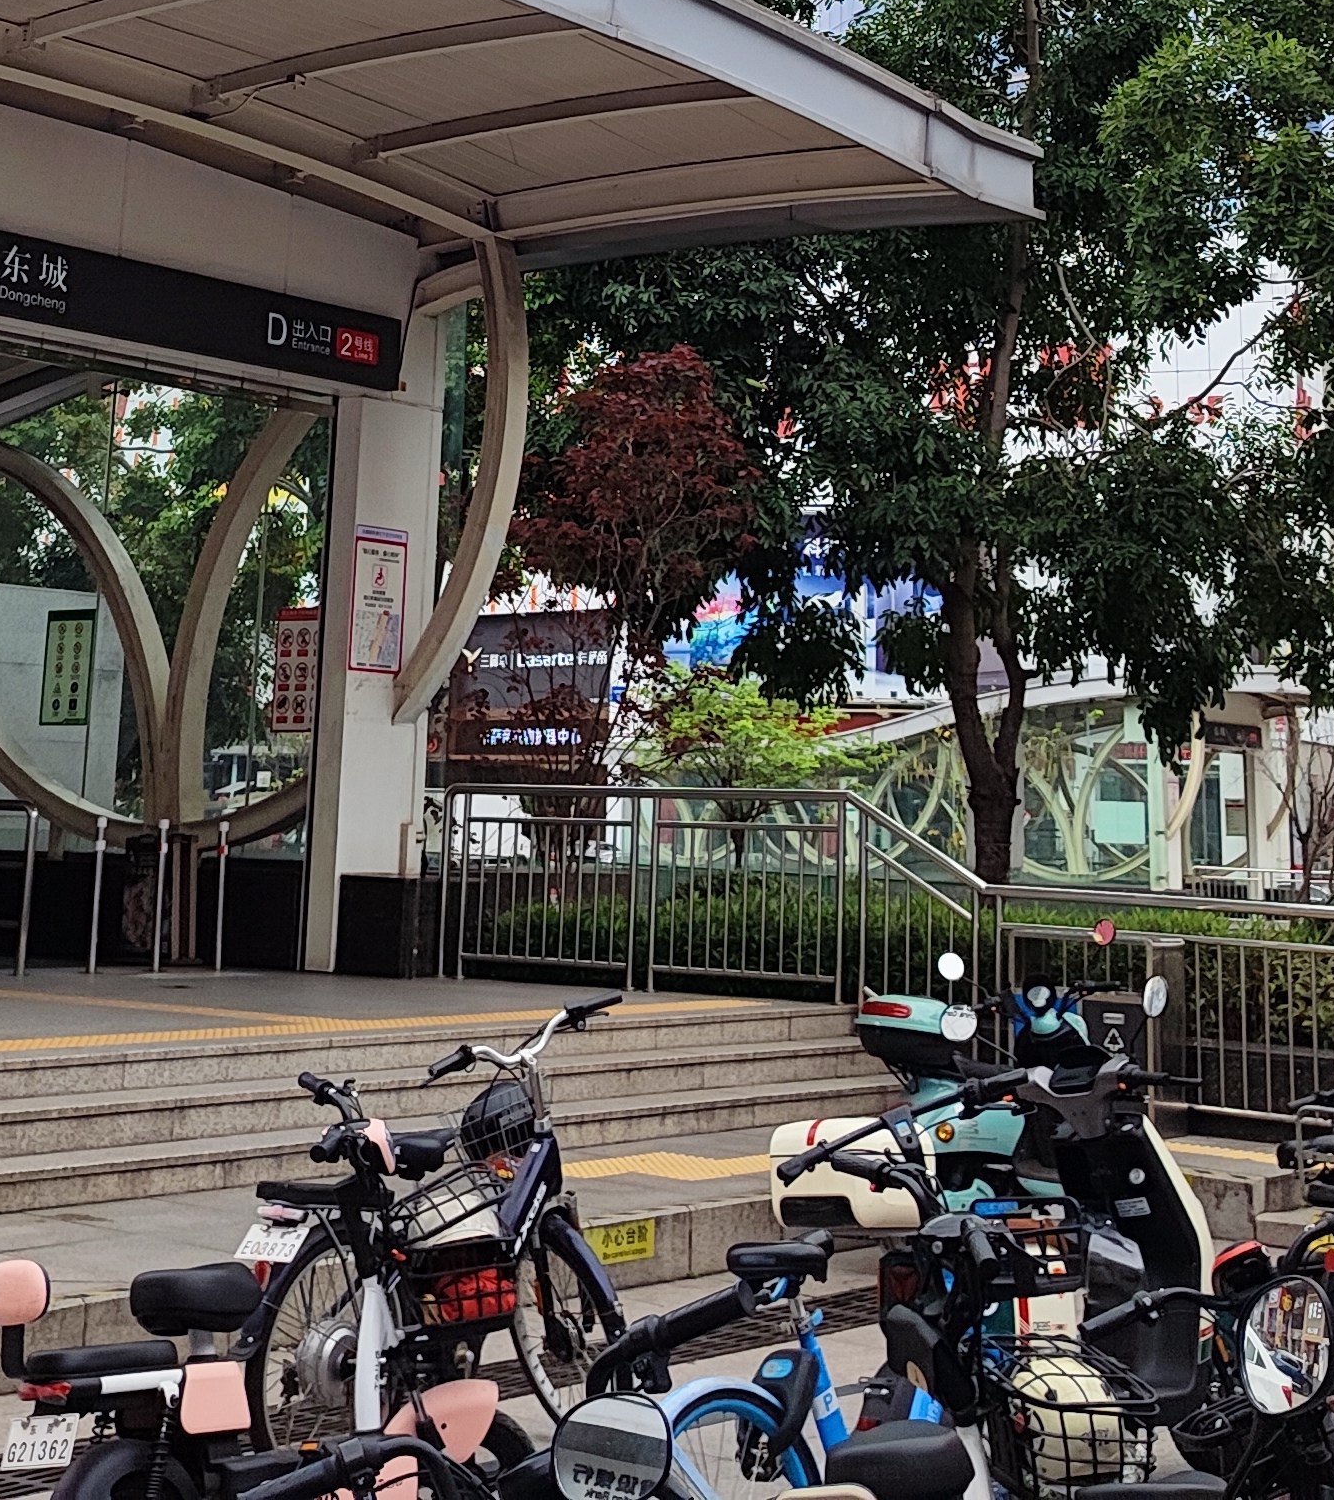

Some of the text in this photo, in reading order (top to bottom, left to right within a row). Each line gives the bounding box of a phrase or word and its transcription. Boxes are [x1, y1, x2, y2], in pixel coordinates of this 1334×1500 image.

[0, 245, 69, 293] 东城
[0, 285, 66, 314] Dongcheng
[268, 312, 288, 346] D
[292, 319, 331, 343] 出入口
[292, 338, 331, 356] Entrance
[241, 1241, 296, 1257] E03873
[602, 1225, 648, 1249] 小心台阶
[7, 1439, 69, 1463] G21362
